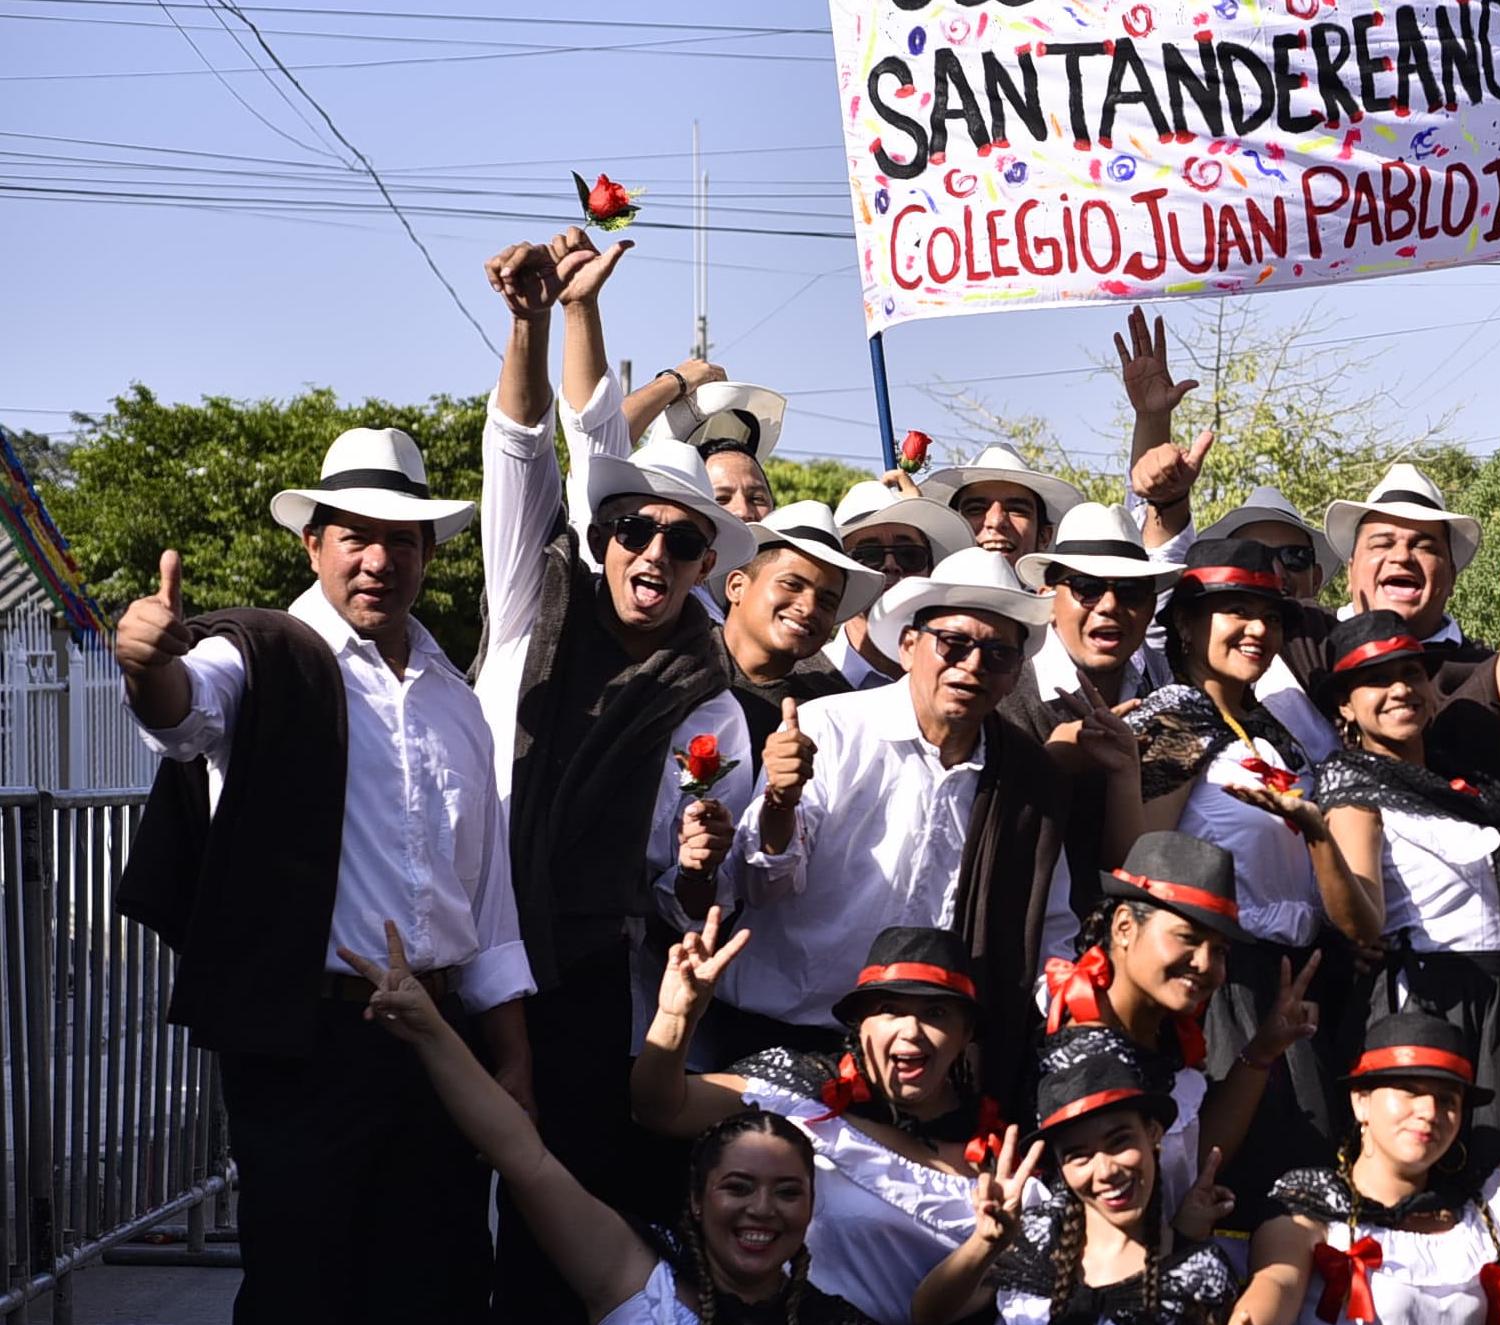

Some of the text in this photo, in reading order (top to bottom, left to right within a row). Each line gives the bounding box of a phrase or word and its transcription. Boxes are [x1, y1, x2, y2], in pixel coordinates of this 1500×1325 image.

[890, 193, 1121, 290] COLEGIO
[1123, 188, 1288, 281] JUAN
[1302, 158, 1479, 259] PABLO
